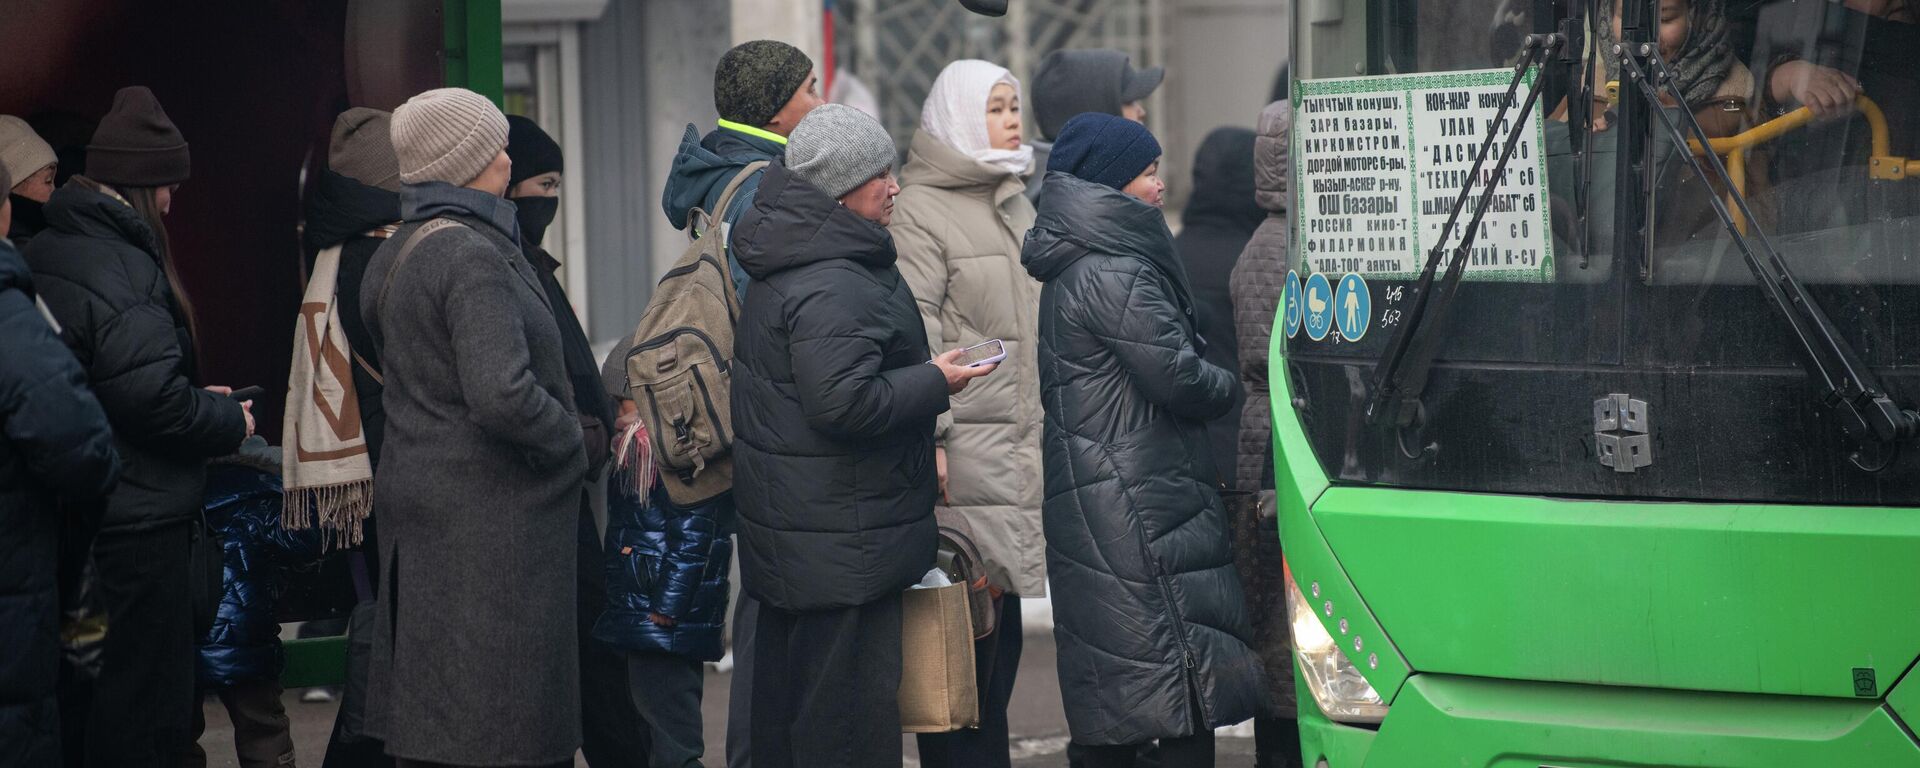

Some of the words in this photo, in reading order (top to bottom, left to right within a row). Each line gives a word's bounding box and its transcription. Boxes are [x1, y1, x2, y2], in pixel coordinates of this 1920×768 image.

[1303, 97, 1354, 113] ТЫНЧТЫК
[1356, 97, 1402, 111] конушу,
[1425, 92, 1471, 111] КОК-ЖАР
[1310, 118, 1339, 133] ЗАРЯ
[1344, 117, 1397, 131] базары,
[1439, 117, 1475, 136] УЛАН
[1305, 135, 1405, 153] КИРКОМСТРОМ,
[1307, 155, 1343, 175] ДОРДОЙ
[1343, 156, 1379, 172] МОТОРС
[1380, 156, 1407, 171] б-ры,
[1313, 177, 1376, 193] КЫЗЫЛ-АСКЕР
[1520, 167, 1534, 186] сб
[1318, 194, 1340, 216] ОШ
[1343, 194, 1398, 215] базары
[1523, 193, 1536, 212] сб
[1311, 218, 1352, 233] РОССИЯ
[1510, 220, 1529, 239] сб
[1307, 236, 1406, 253] ФИЛАРМОНИЯ
[1315, 258, 1363, 273] “АЛА-ТОО”
[1367, 259, 1401, 272] аянты
